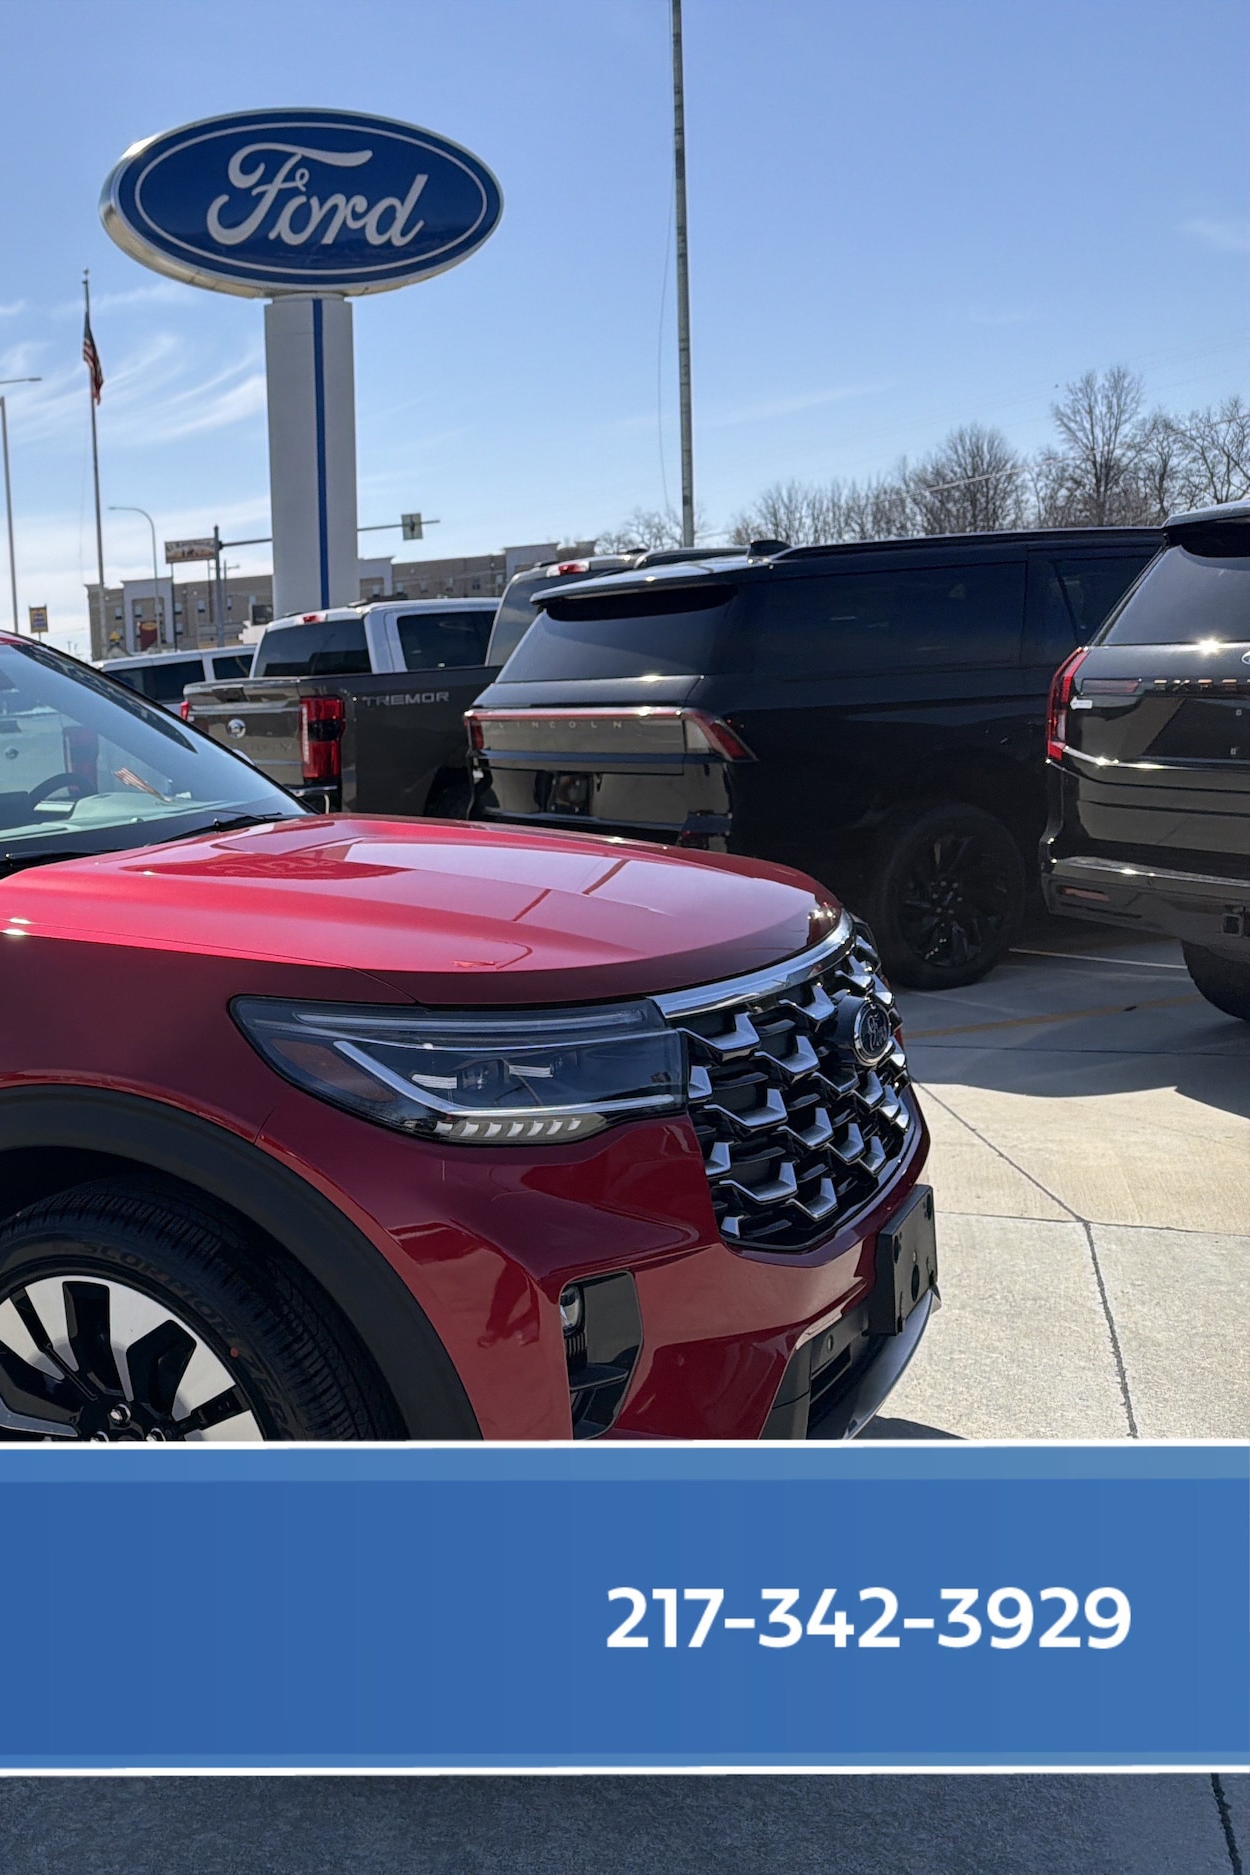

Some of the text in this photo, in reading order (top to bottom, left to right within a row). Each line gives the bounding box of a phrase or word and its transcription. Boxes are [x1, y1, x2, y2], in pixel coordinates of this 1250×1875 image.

[206, 142, 429, 246] Ford
[1153, 679, 1250, 691] EXPE
[362, 691, 450, 707] TREMOR
[499, 720, 623, 729] LINCOLN
